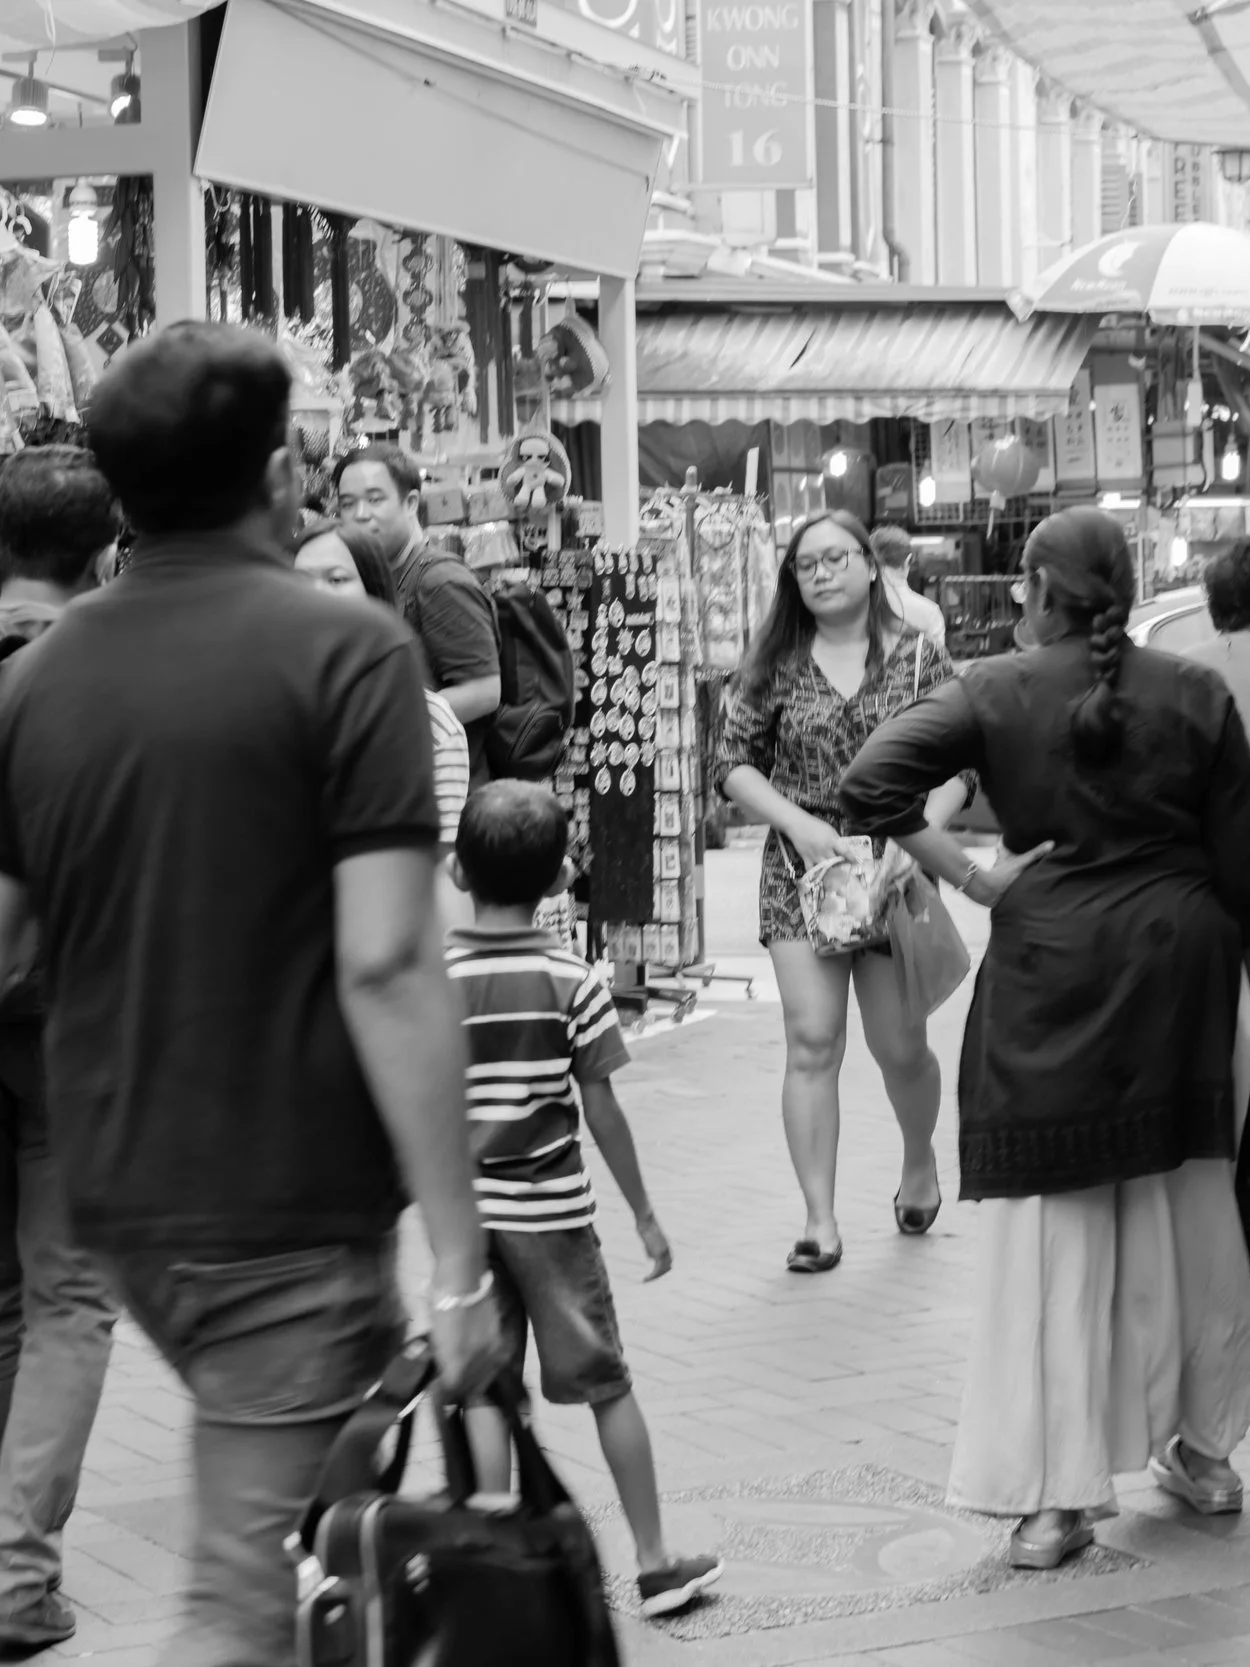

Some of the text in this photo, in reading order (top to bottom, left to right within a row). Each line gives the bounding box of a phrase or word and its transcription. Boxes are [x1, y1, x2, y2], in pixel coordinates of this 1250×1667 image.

[706, 3, 798, 31] KWONG
[726, 44, 779, 70] ONN
[723, 80, 788, 108] TONG
[726, 128, 783, 167] 16
